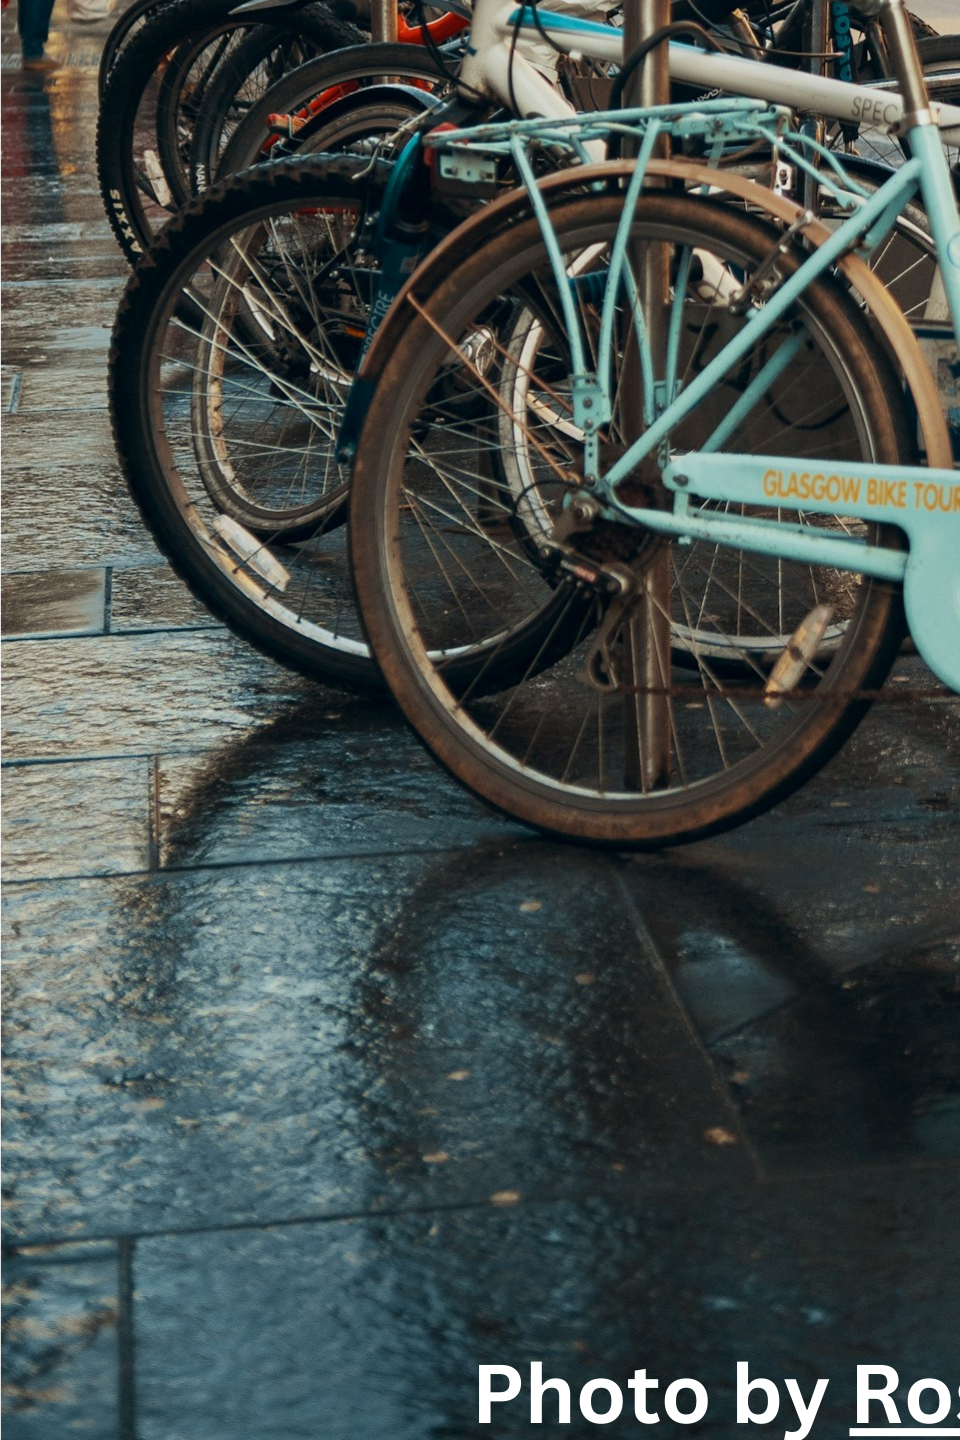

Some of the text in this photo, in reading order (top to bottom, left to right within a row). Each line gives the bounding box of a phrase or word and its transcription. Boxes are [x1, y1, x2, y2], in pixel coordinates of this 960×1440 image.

[851, 96, 902, 125] SPEC
[763, 468, 862, 504] GLASGOW
[865, 478, 907, 508] BIKE
